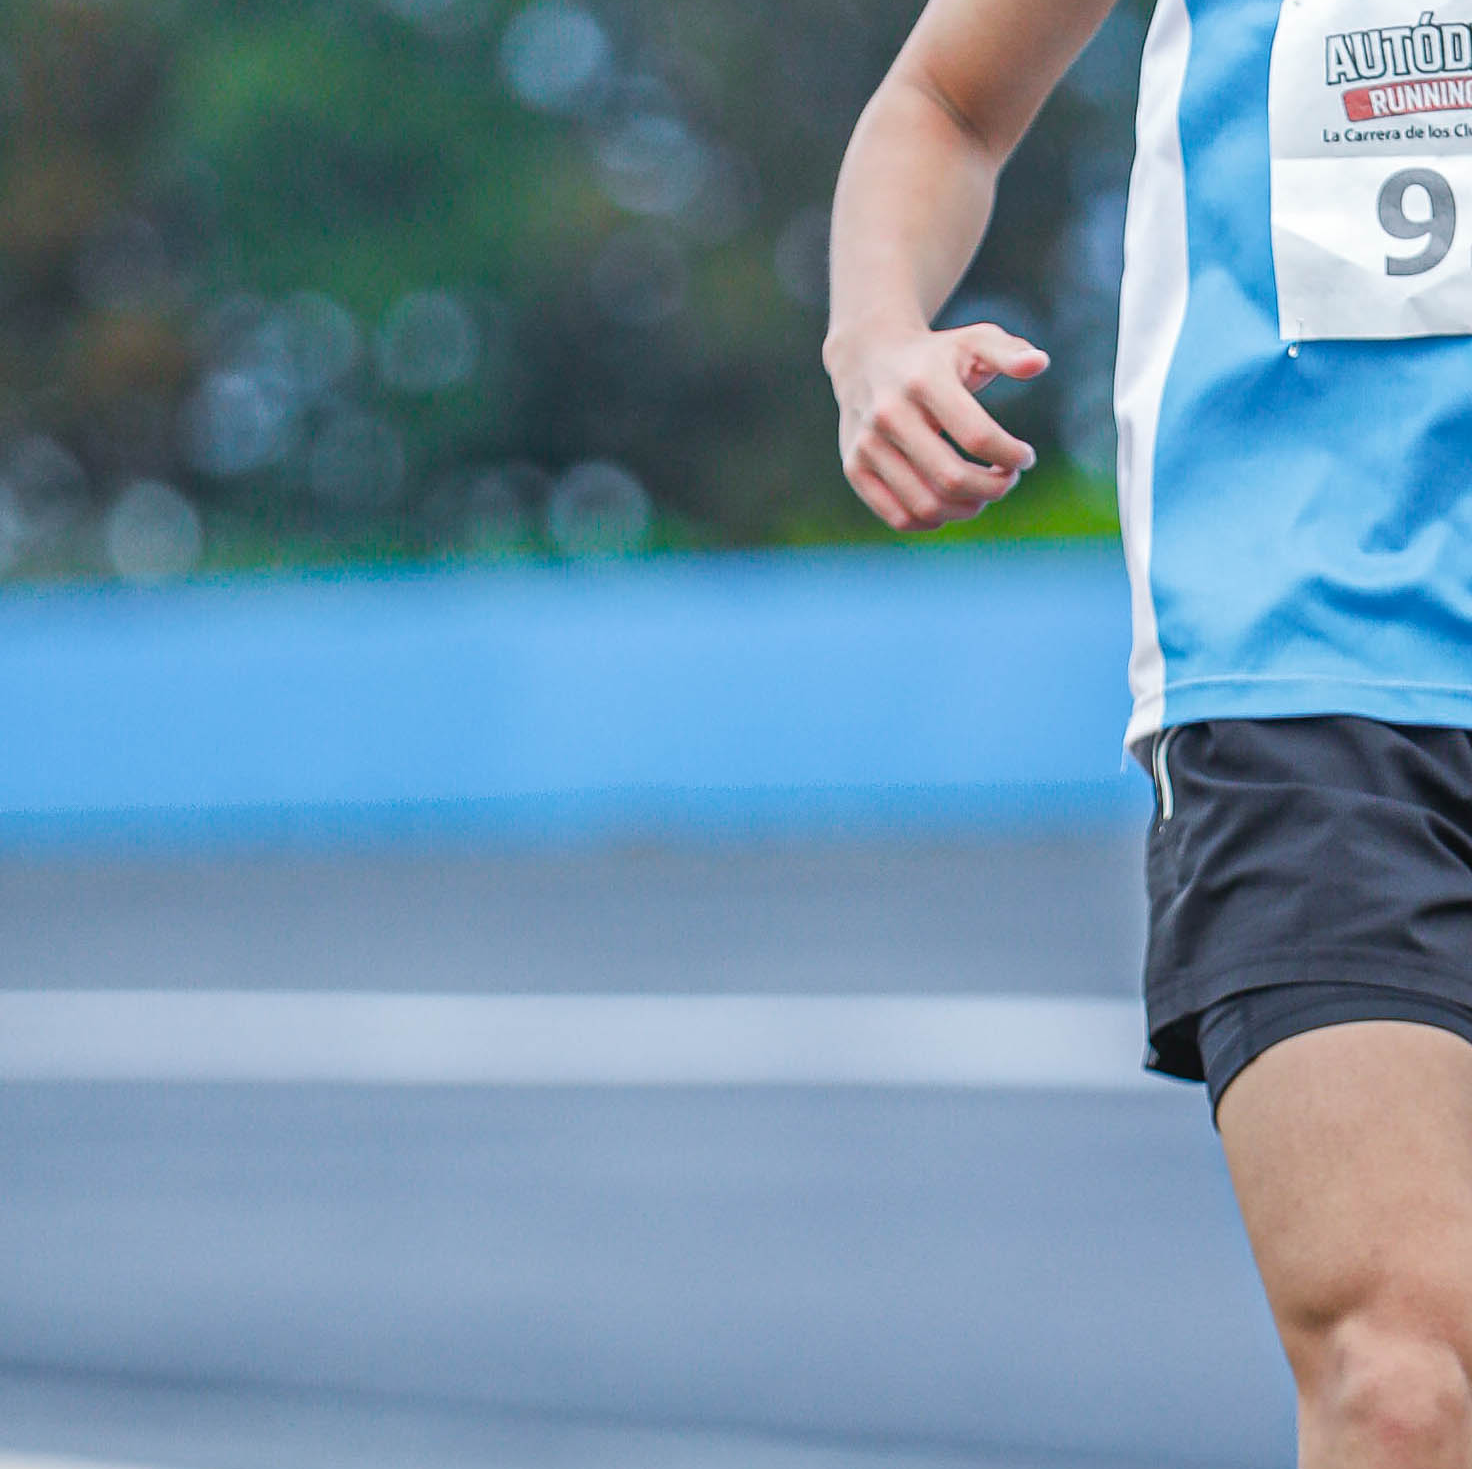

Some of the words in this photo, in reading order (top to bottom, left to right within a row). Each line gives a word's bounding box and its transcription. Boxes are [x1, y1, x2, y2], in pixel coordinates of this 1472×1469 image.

[1322, 128, 1341, 143] La
[1344, 128, 1401, 142] Carrera
[1405, 125, 1425, 139] de
[1428, 123, 1450, 139] los
